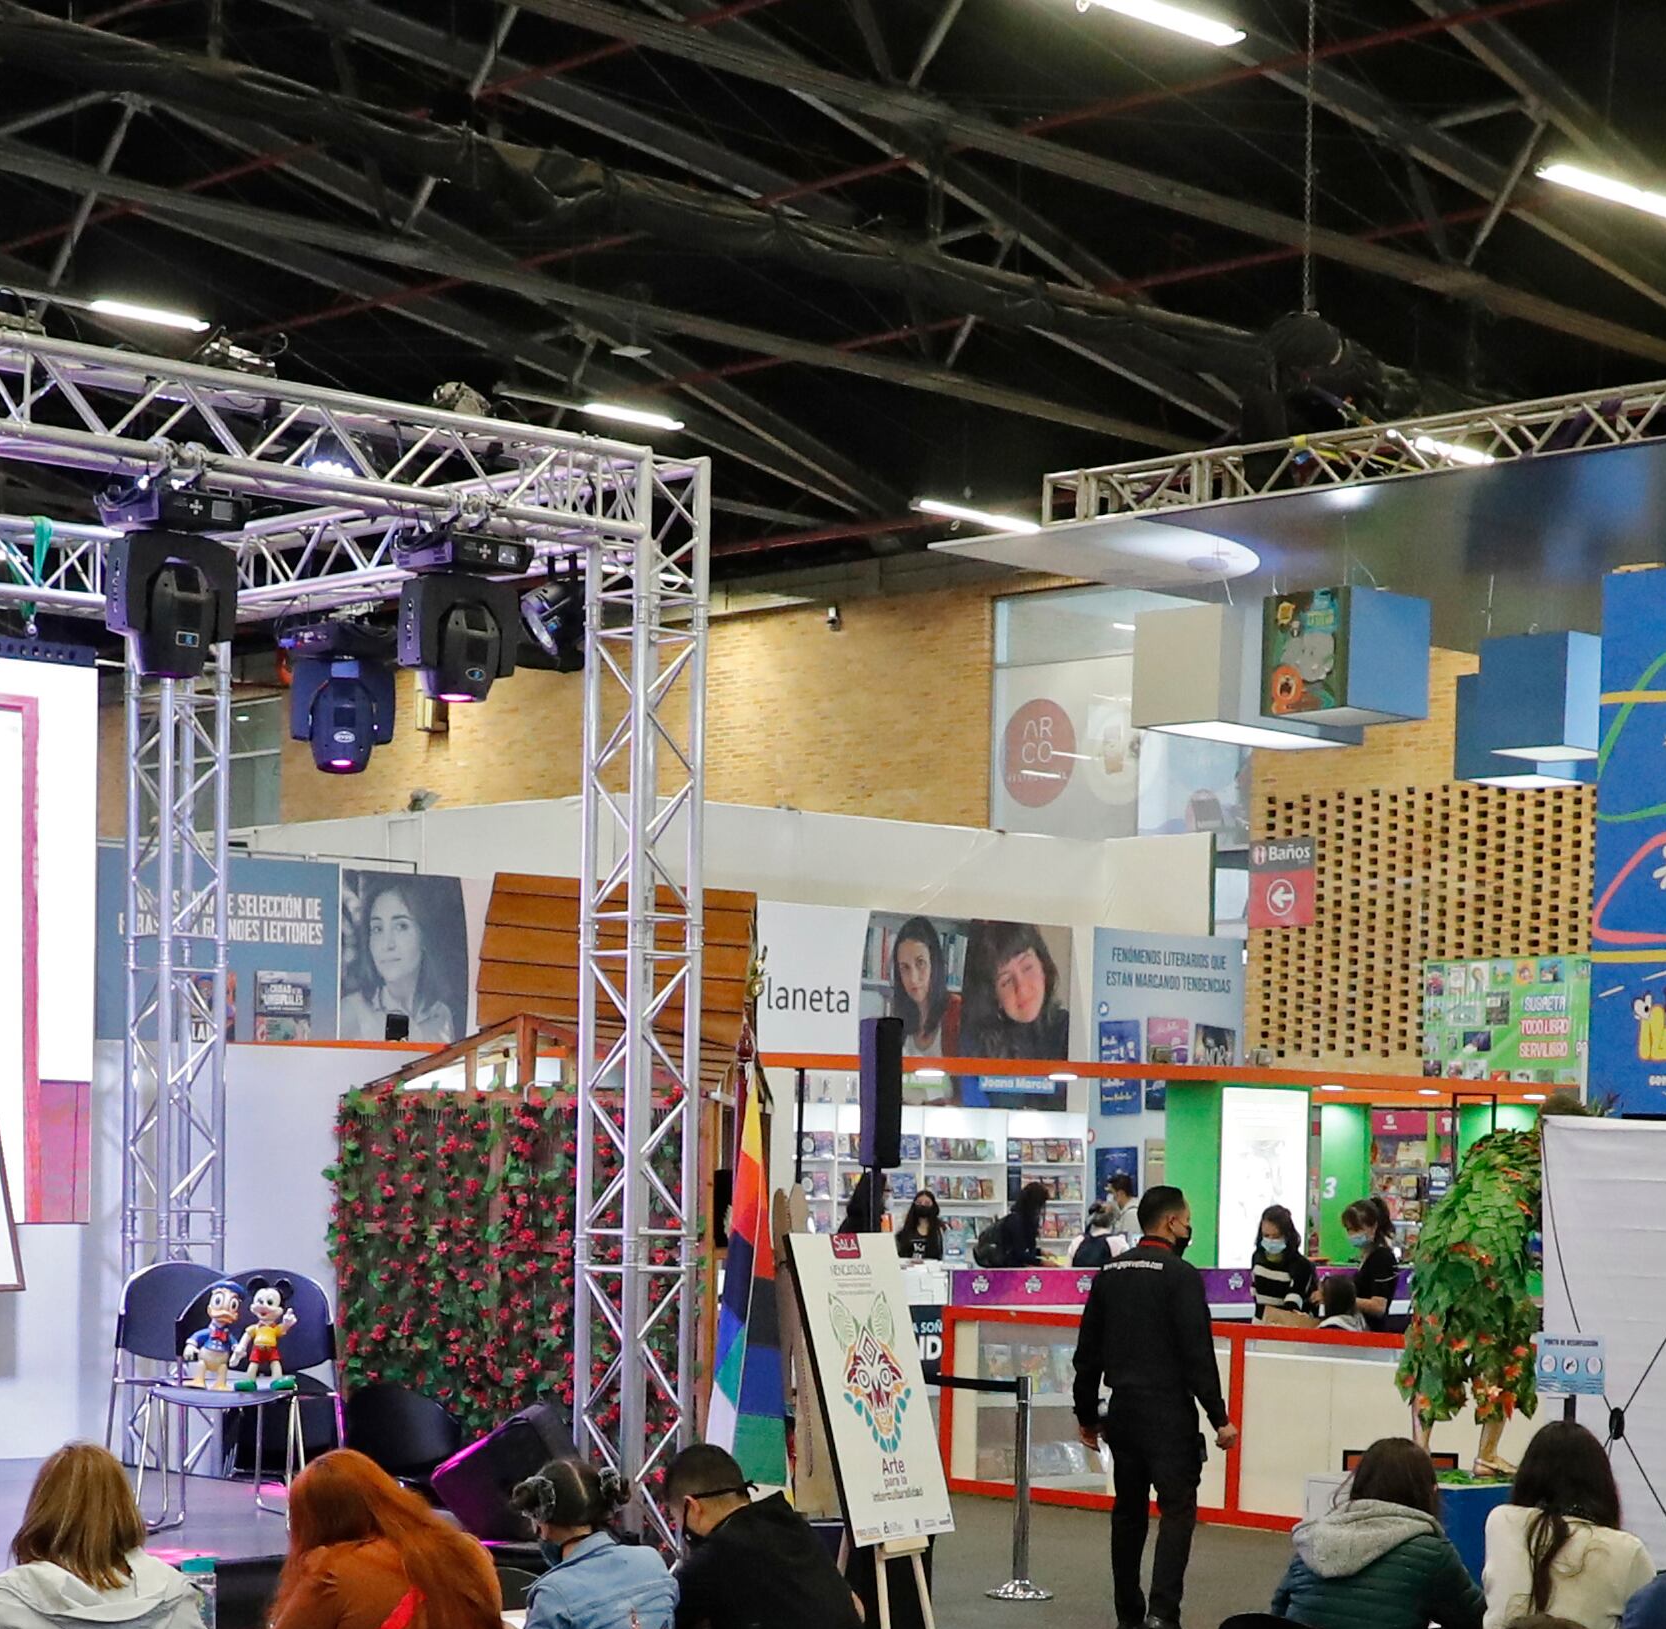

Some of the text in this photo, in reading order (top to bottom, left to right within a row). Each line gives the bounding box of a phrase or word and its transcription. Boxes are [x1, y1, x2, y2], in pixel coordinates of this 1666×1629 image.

[1268, 844, 1311, 861] Baños
[237, 893, 303, 919] SELECCIÓN
[305, 897, 322, 920] DE
[263, 922, 324, 945] LECTORES
[1111, 946, 1227, 970] FENÓMENOS LITERARIOS QUE
[1134, 973, 1181, 991] MARCANDO
[1182, 976, 1232, 994] TENDENCIAS
[765, 979, 851, 1014] laneta
[1322, 1176, 1338, 1199] 3
[882, 1457, 906, 1475] Arte
